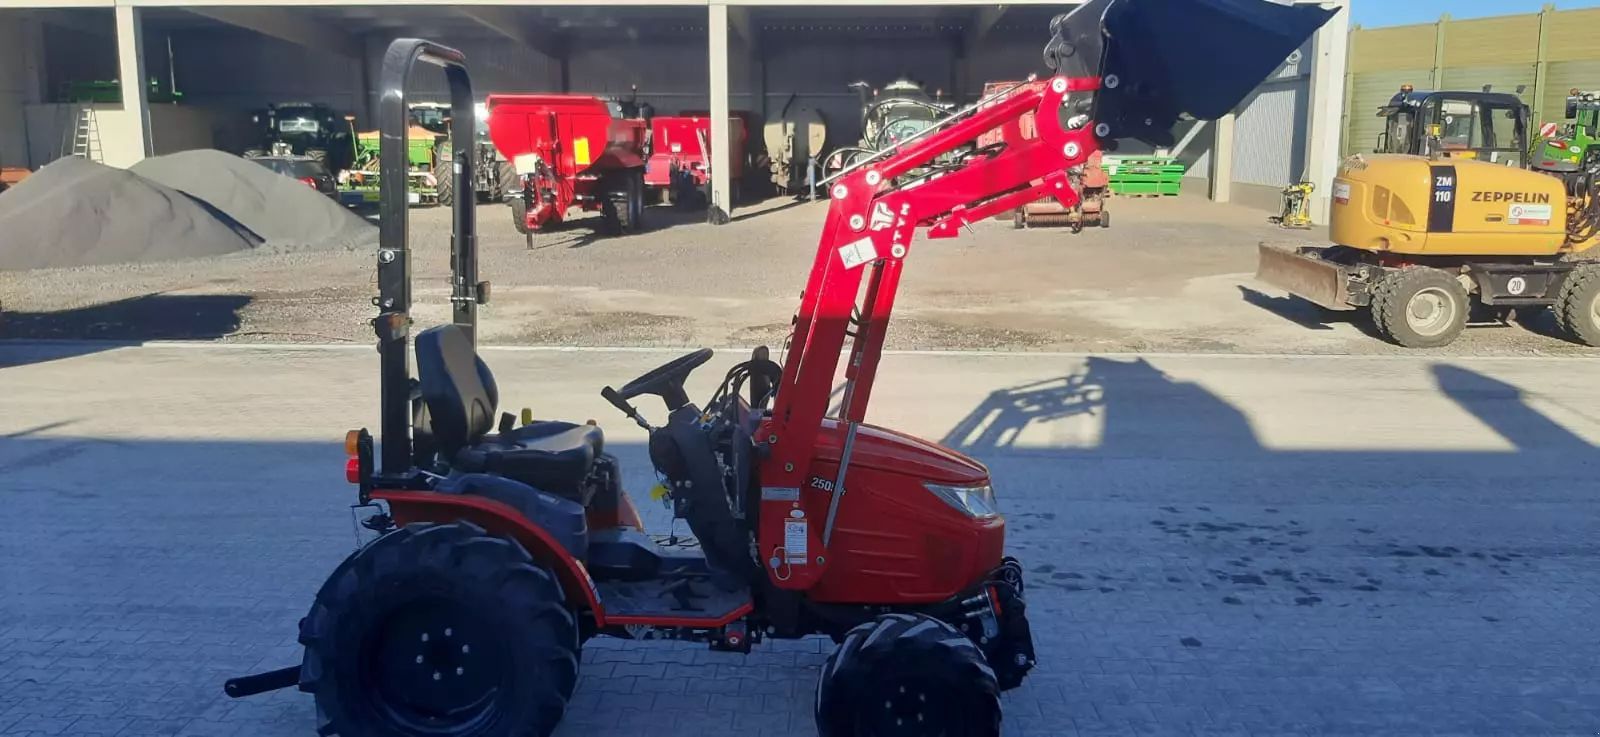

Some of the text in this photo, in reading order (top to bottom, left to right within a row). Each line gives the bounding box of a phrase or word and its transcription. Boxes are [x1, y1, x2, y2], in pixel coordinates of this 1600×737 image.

[1436, 176, 1452, 186] ZM
[1435, 191, 1451, 202] 110
[1471, 191, 1550, 204] ZEPPELIN
[1511, 280, 1522, 292] 20
